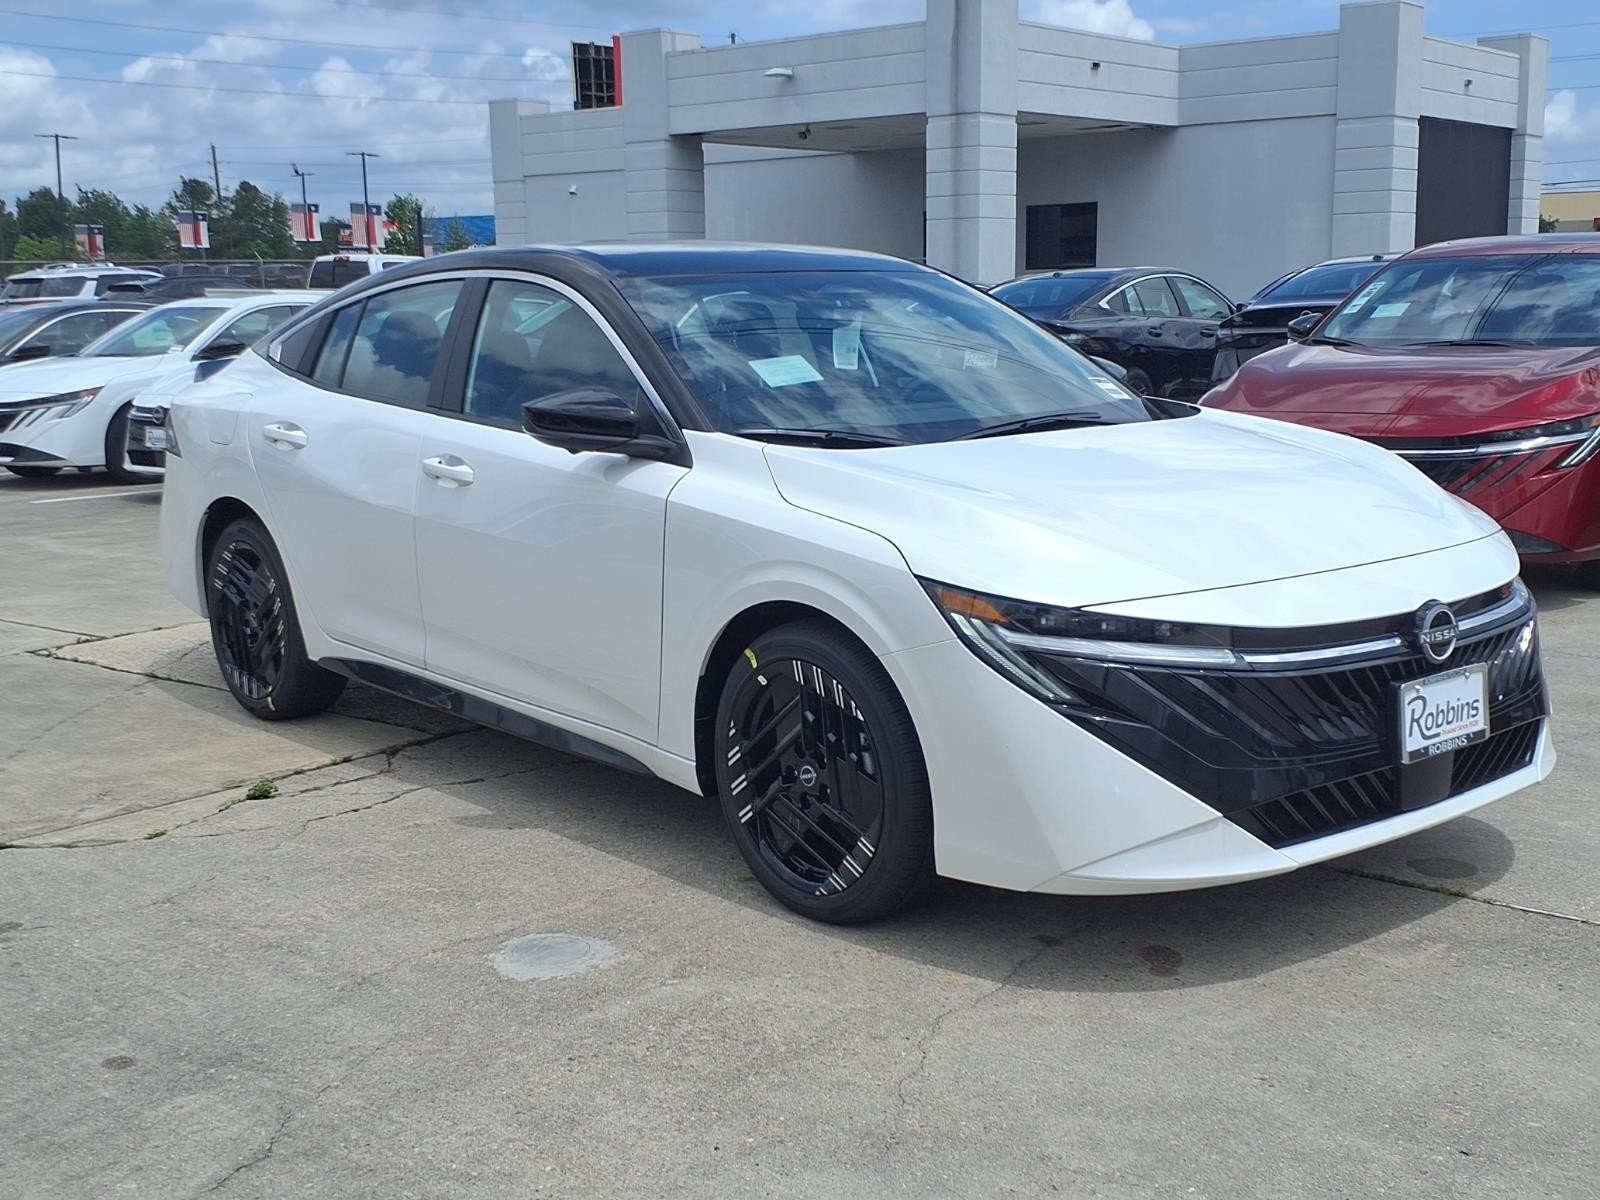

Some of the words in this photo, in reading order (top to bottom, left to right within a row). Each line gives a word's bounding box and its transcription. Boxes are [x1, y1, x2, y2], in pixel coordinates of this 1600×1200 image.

[1420, 628, 1458, 644] NISSA
[1407, 695, 1480, 741] Robbins
[1428, 735, 1468, 756] ROBBINS
